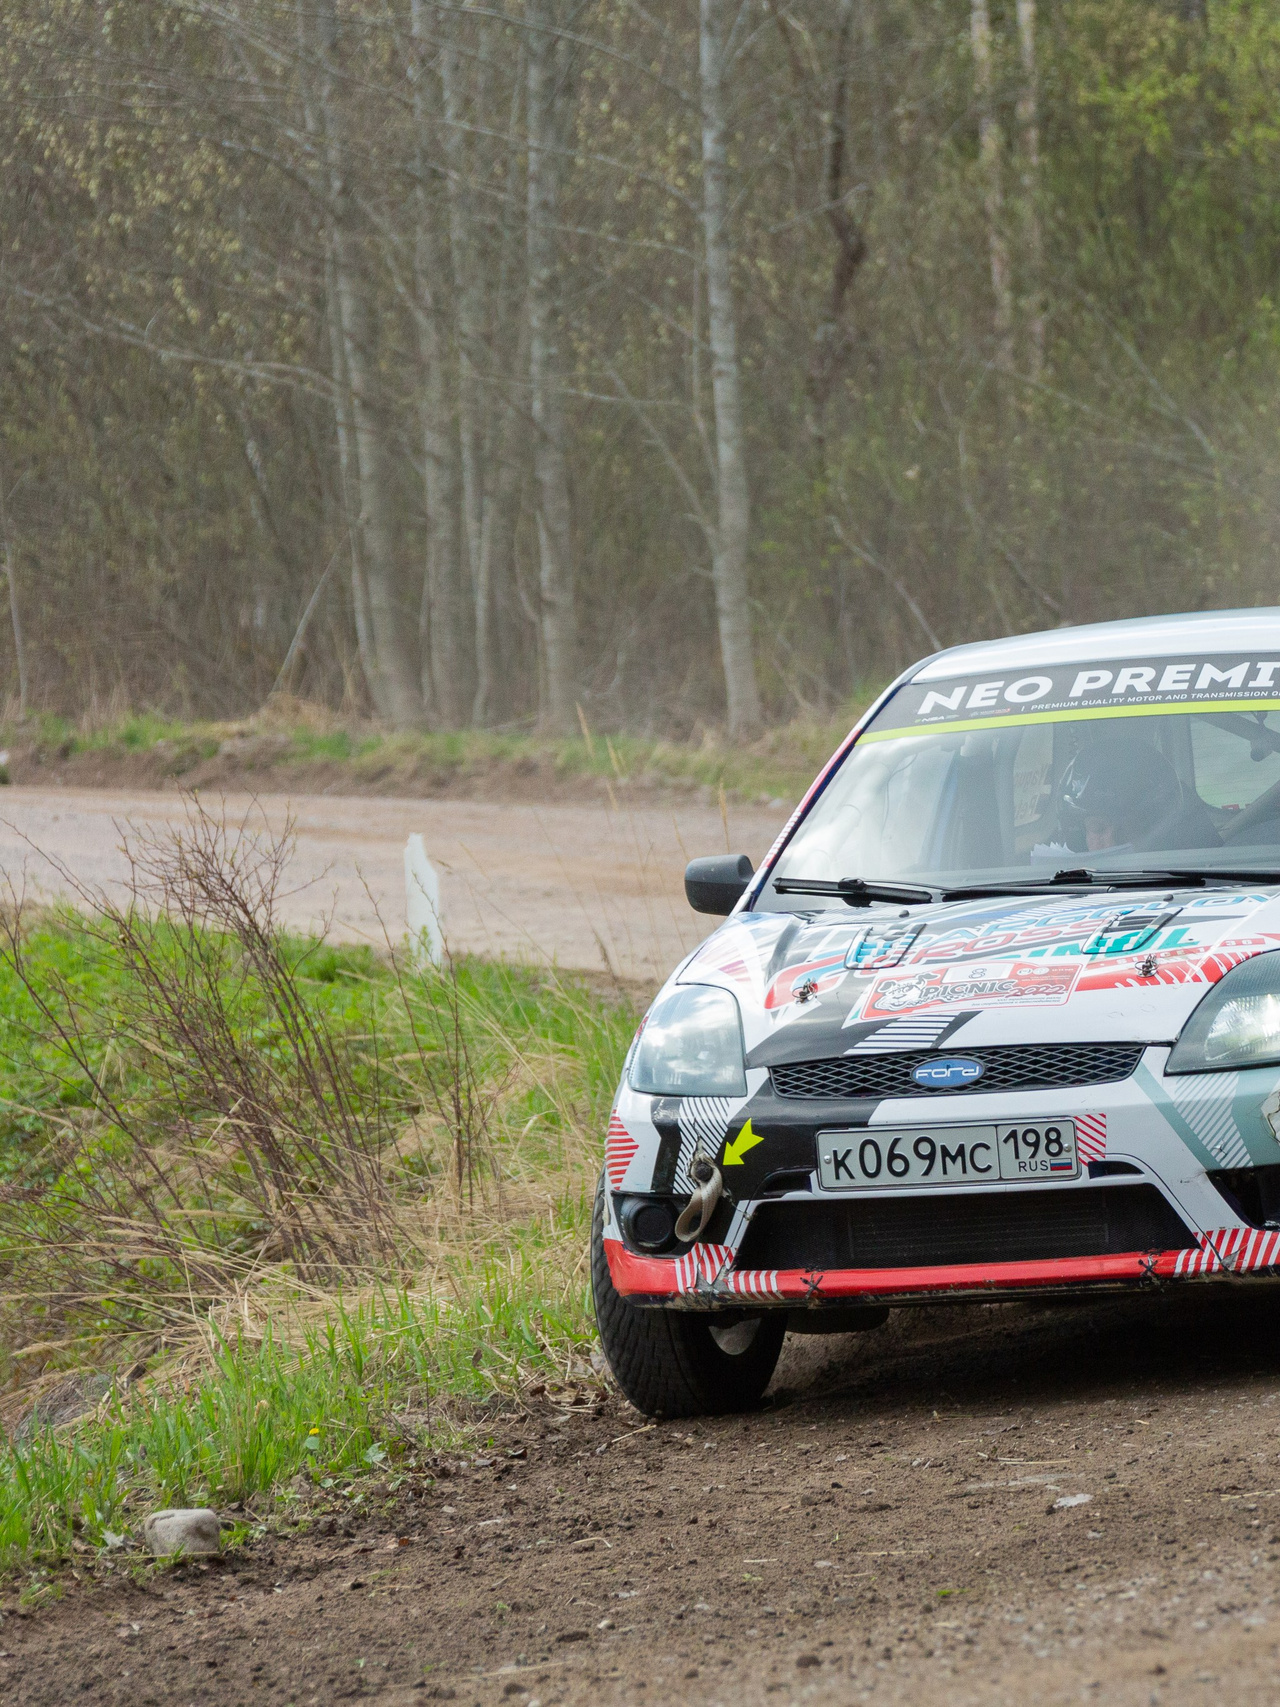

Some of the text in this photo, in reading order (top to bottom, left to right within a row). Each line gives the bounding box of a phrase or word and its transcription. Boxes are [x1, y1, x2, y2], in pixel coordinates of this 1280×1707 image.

[917, 676, 1053, 715] NEO
[1030, 700, 1079, 711] PREMIUM
[1081, 697, 1125, 706] QUALITY
[1127, 694, 1162, 703] MOTOR
[1191, 690, 1269, 699] TRANSMISSION
[968, 967, 988, 980] 8
[921, 979, 1018, 1000] PICNIC
[1009, 984, 1067, 998] 2022
[1002, 1126, 1064, 1160] 198
[1018, 1158, 1049, 1173] RUS
